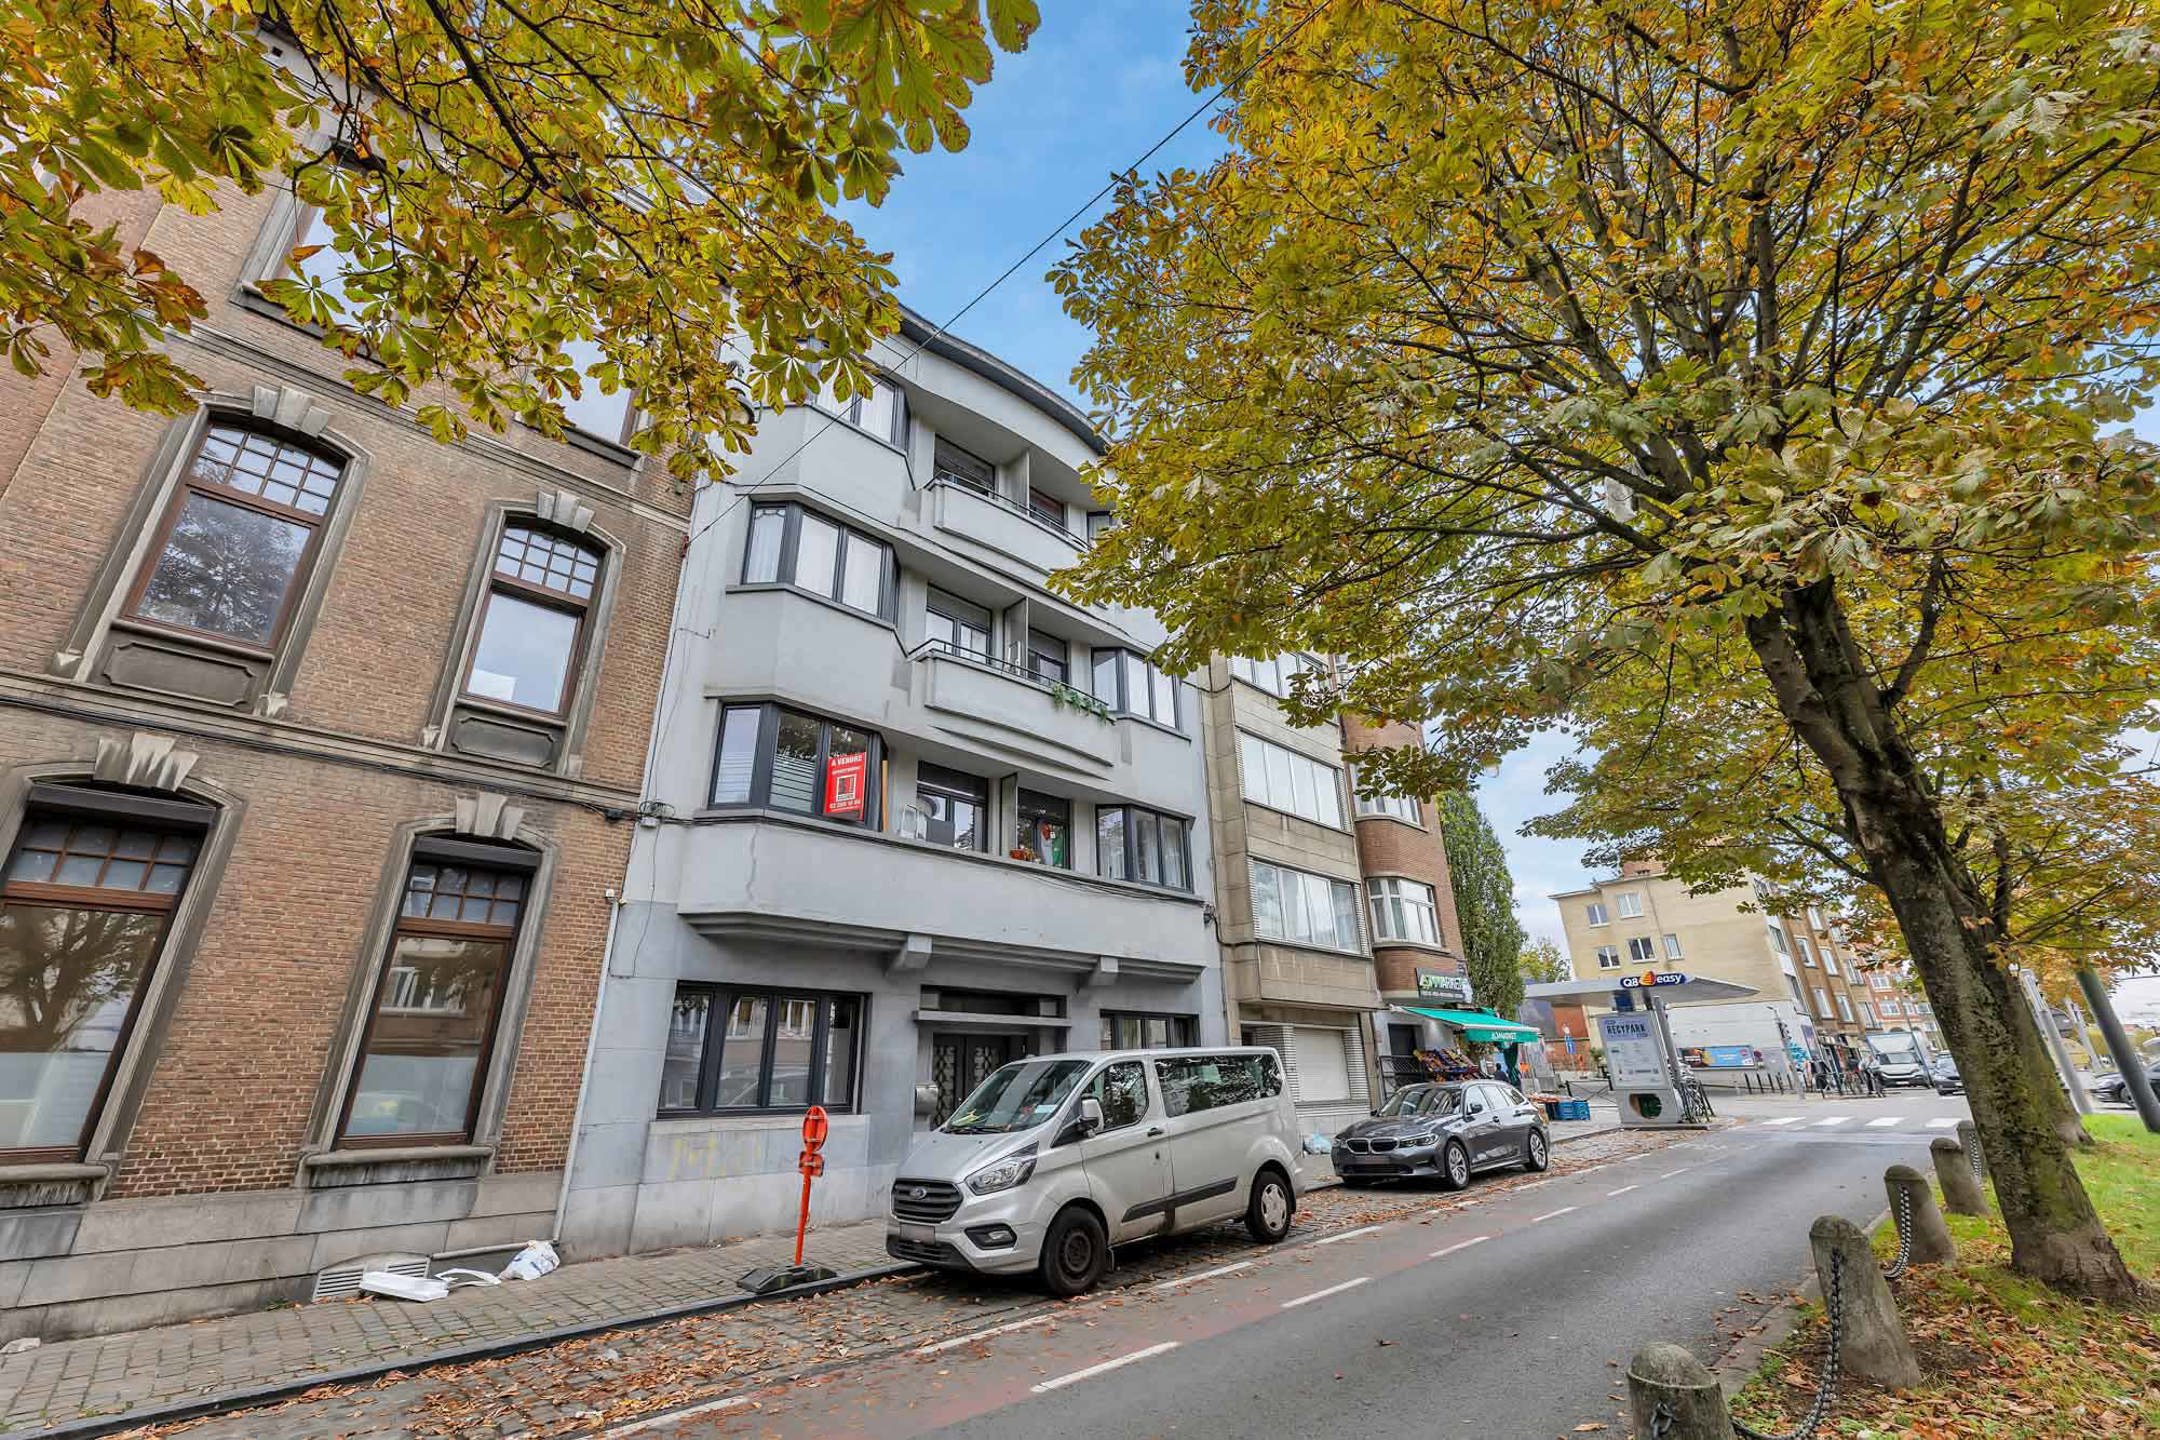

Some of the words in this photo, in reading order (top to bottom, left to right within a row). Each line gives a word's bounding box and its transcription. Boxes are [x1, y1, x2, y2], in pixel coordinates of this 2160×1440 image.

[1623, 978, 1639, 987] Q8
[1656, 974, 1681, 984] easy
[1606, 1023, 1645, 1034] RECYPARK
